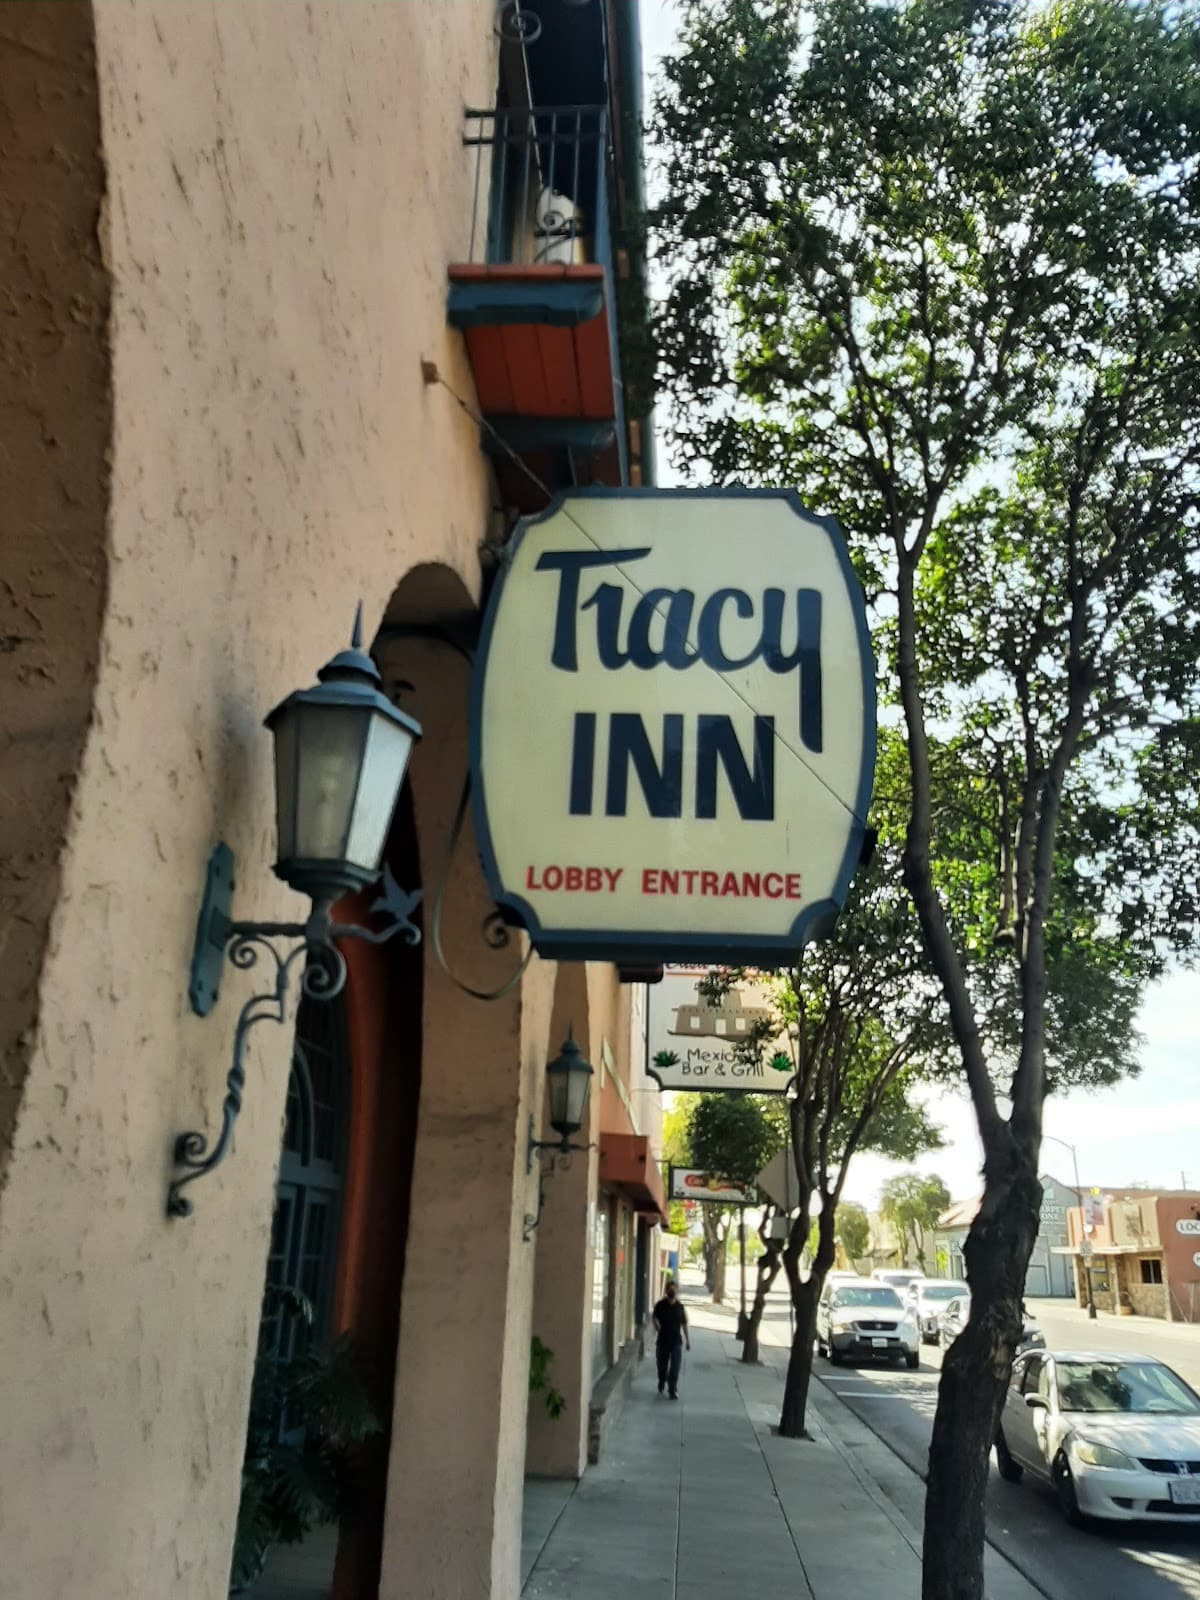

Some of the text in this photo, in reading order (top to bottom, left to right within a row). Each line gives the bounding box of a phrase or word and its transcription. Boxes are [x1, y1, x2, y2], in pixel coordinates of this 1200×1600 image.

[534, 547, 823, 753] Tracy
[569, 712, 775, 821] INN
[526, 865, 802, 899] LOBBY ENTRANCE
[682, 1061, 764, 1077] Bar & Grill
